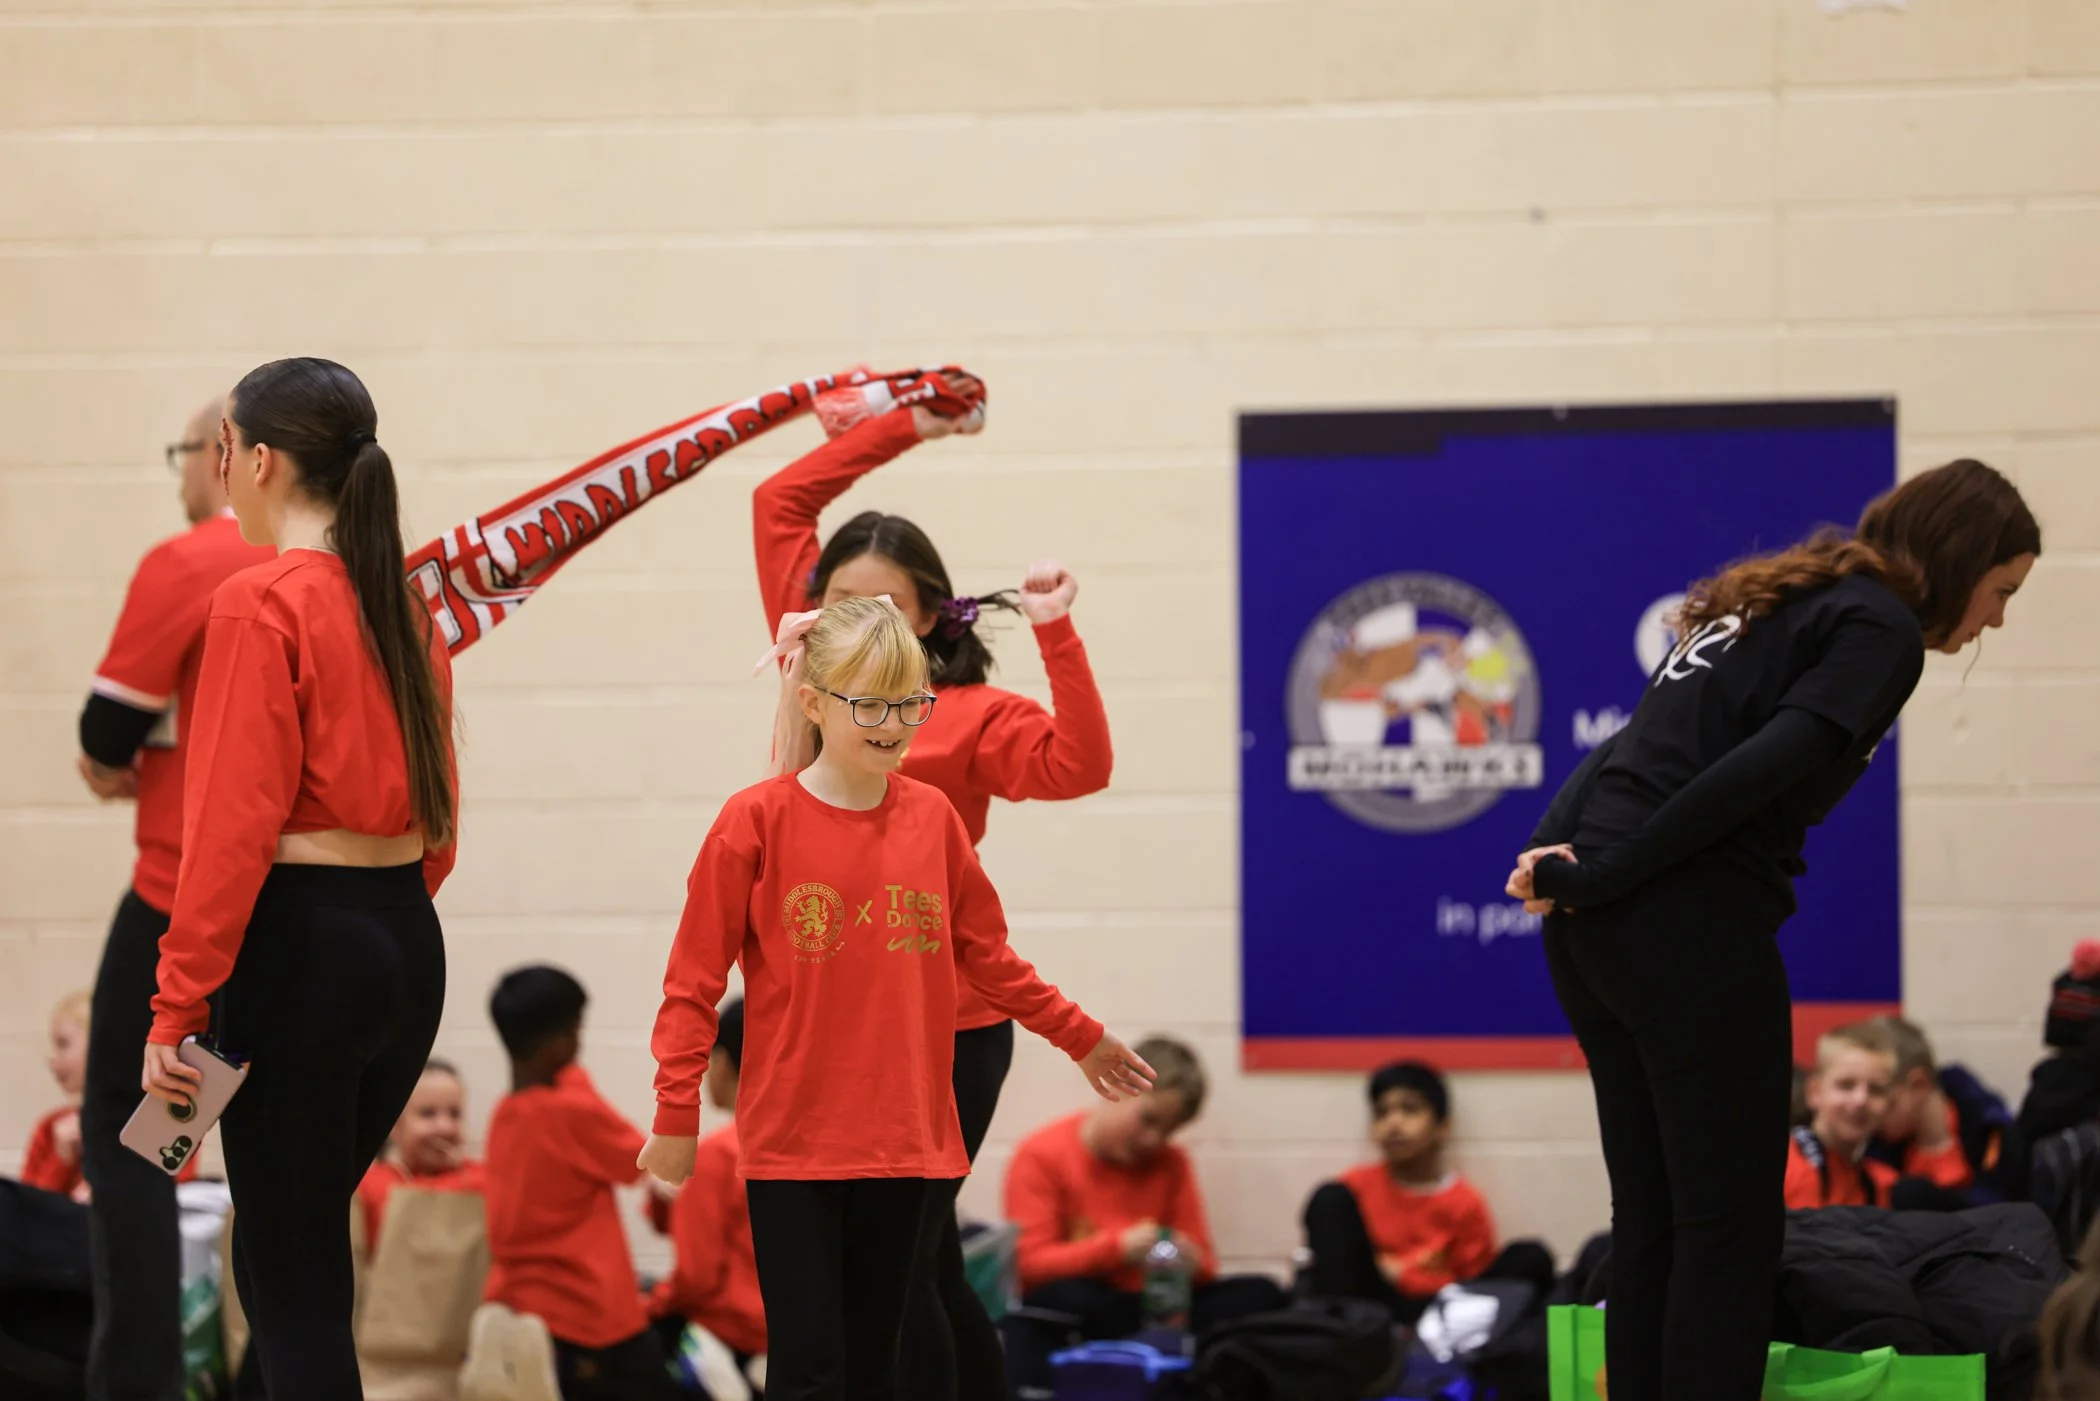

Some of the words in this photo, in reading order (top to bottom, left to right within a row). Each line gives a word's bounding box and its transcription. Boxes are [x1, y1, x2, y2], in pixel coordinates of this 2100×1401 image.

[784, 885, 841, 913] MIDDLESBROUGH
[885, 884, 943, 914] Tees
[886, 909, 943, 931] Dance
[789, 930, 825, 950] OOTBALL
